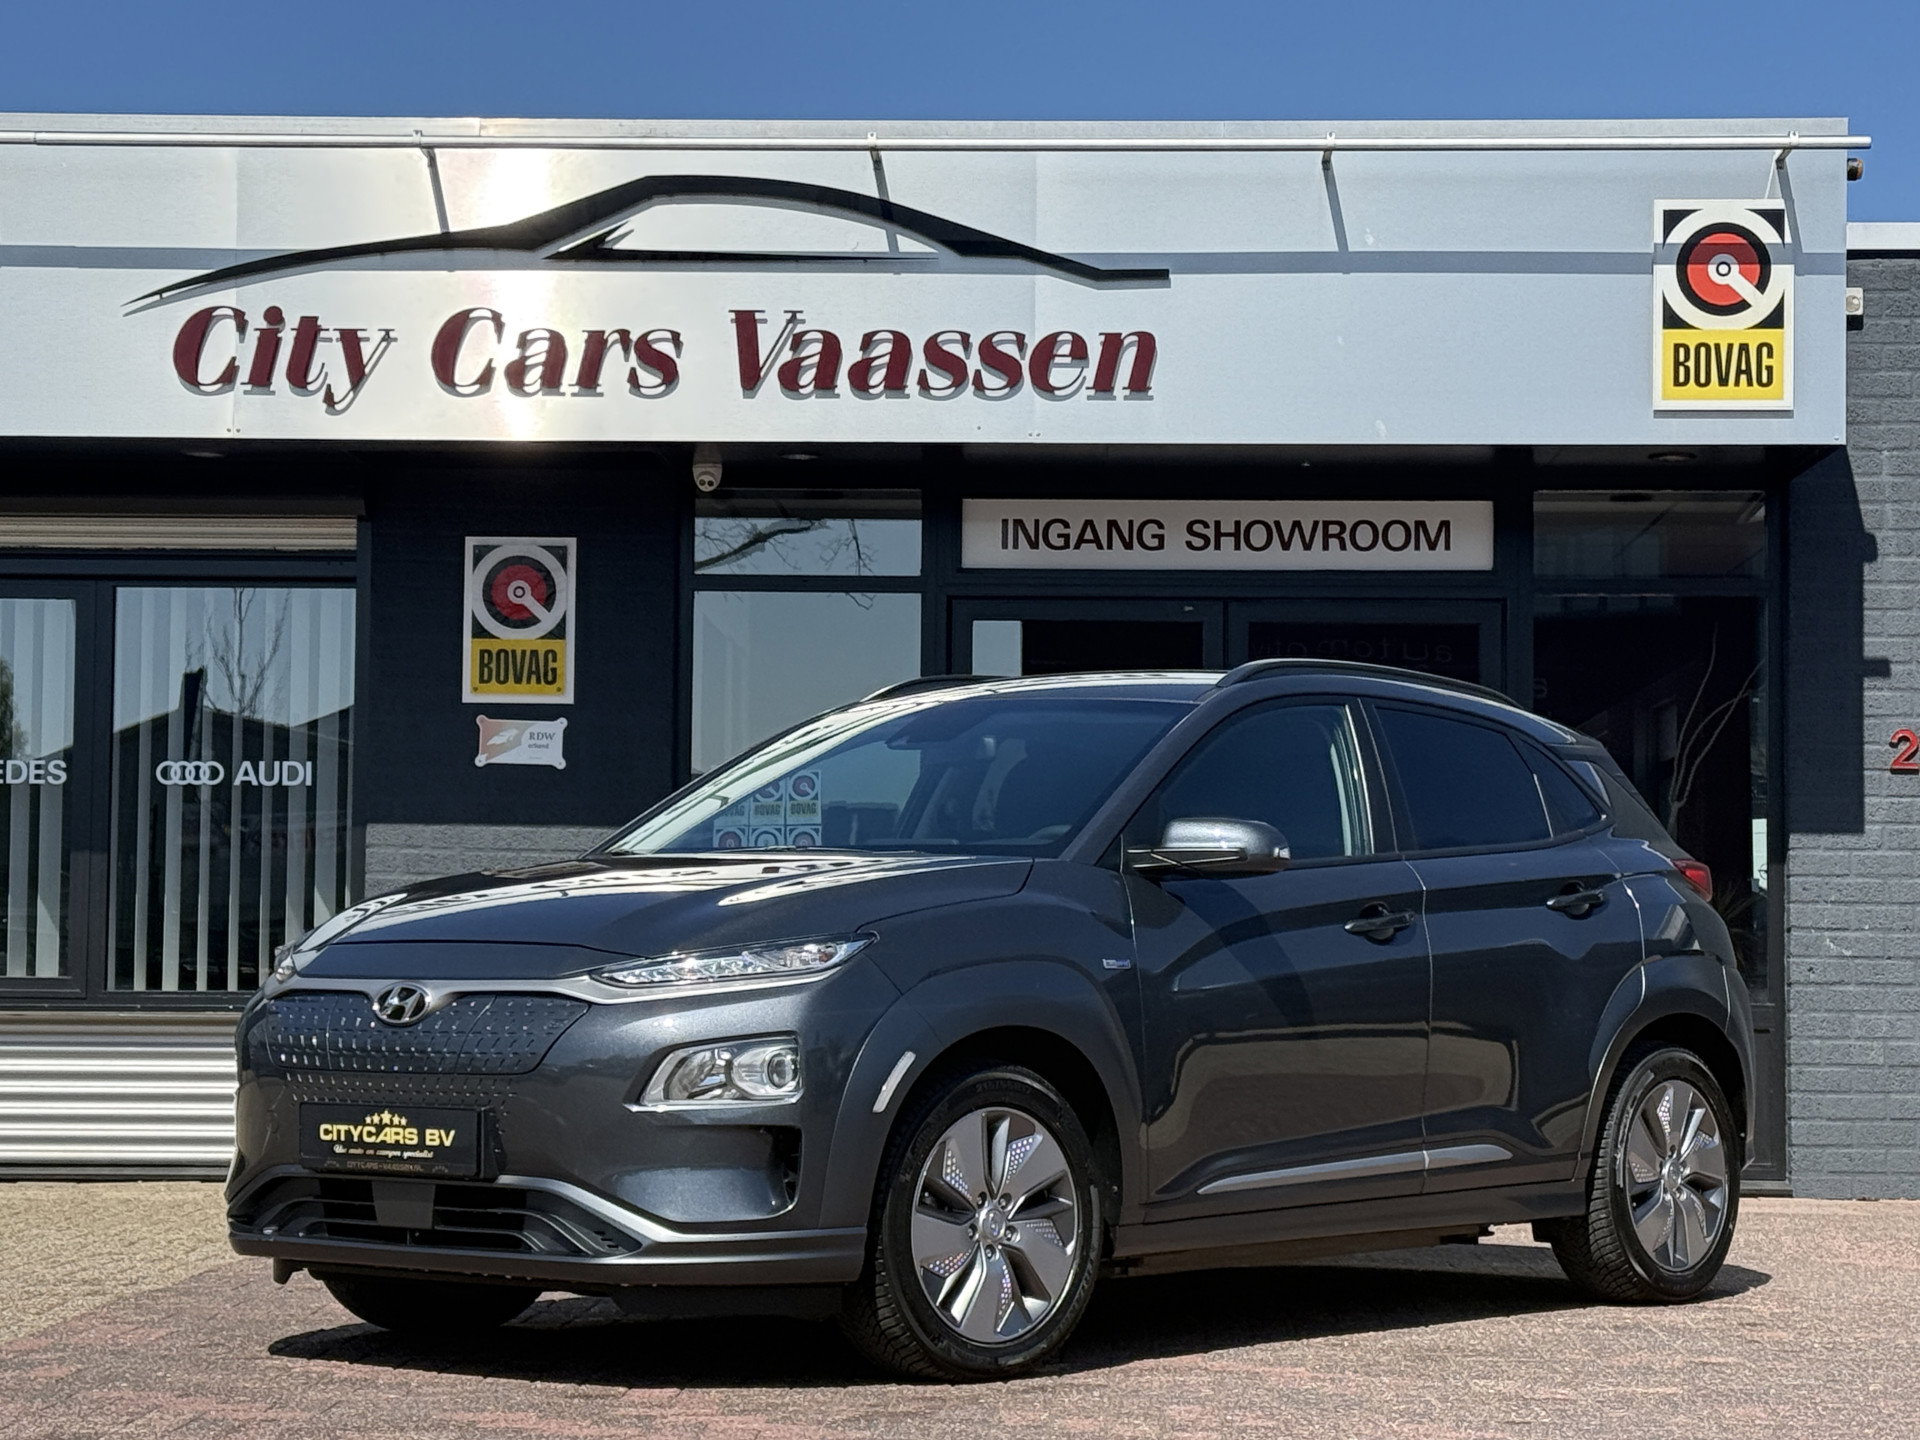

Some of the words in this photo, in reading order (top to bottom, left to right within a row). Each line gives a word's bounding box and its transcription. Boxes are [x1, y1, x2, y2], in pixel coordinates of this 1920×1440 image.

[173, 305, 397, 409] City
[431, 306, 683, 397] Cars
[728, 309, 1157, 397] Vaassen
[1673, 342, 1774, 388] BOVAG
[1000, 517, 1166, 551] INGANG
[1184, 518, 1452, 552] SHOWROOM
[479, 648, 558, 686] BOVAG
[529, 731, 556, 741] RDW
[233, 760, 313, 787] AUDI
[319, 1123, 419, 1146] CITYCARS
[425, 1128, 456, 1148] BV
